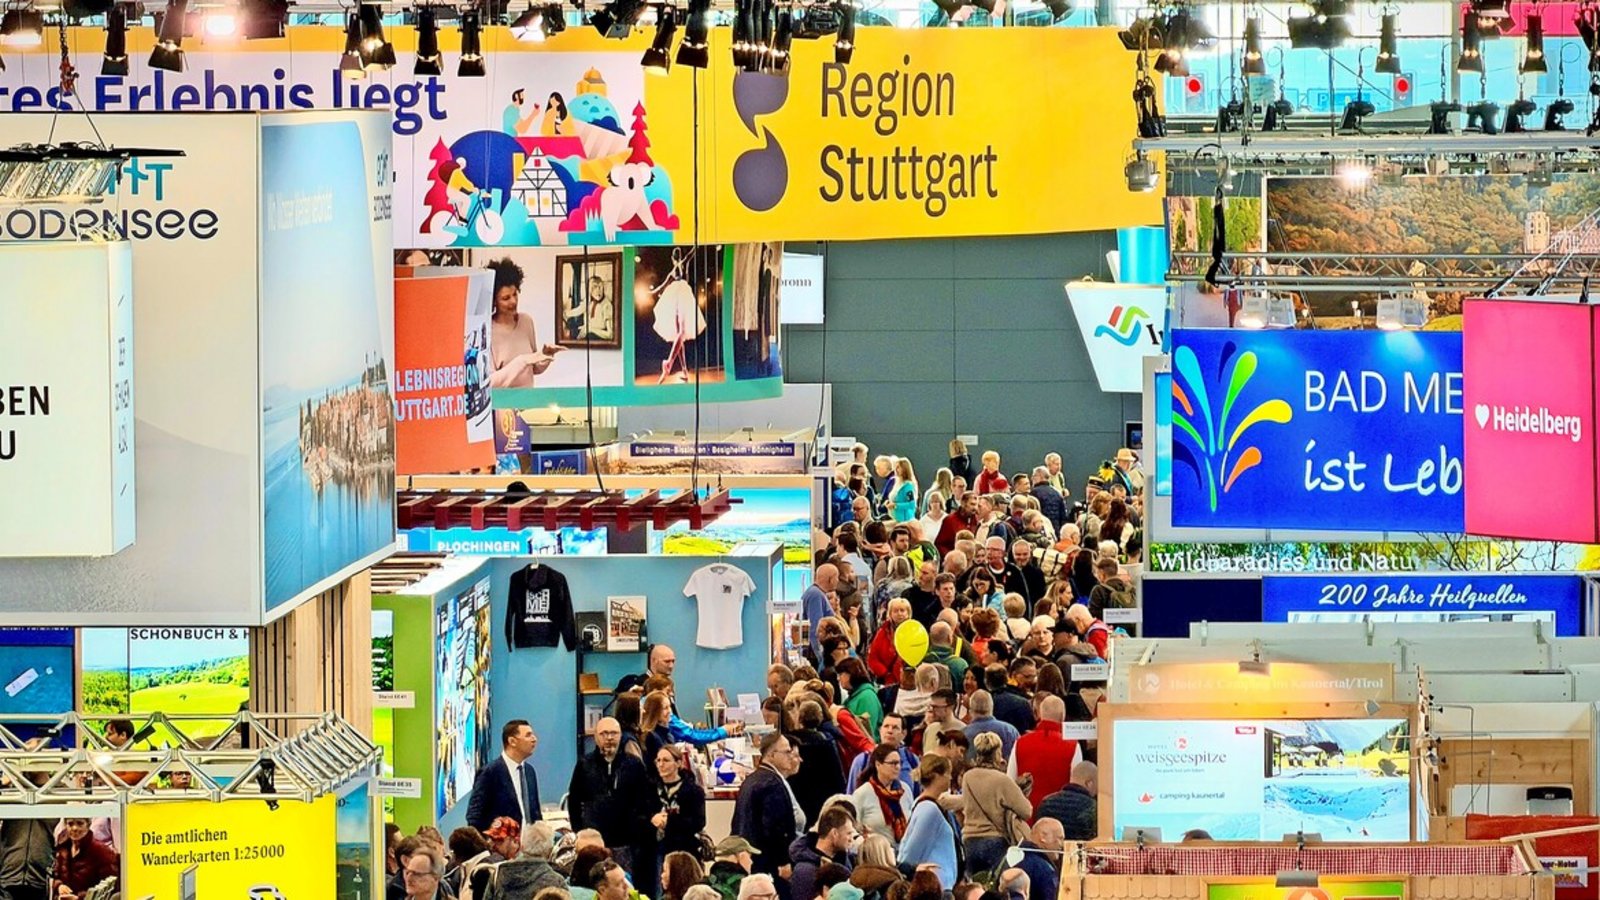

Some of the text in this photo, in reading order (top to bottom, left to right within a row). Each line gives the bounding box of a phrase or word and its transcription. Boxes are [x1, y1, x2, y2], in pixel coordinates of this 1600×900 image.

[95, 68, 314, 111] Erlebnis
[333, 69, 447, 135] liegt
[820, 54, 954, 136] Region
[818, 144, 998, 217] Stuttgart
[1305, 370, 1463, 414] BAD ME
[1493, 405, 1581, 442] Heidelberg
[1304, 439, 1463, 496] ist Leb
[437, 541, 520, 552] PLOCHINGEN
[1157, 551, 1305, 571] Wildparadies
[1313, 553, 1352, 572] und
[1318, 583, 1527, 609] 200 Jahre Heilquellen
[229, 628, 238, 640] &
[141, 829, 228, 846] Die amtlichen
[141, 850, 230, 866] Wanderkarten
